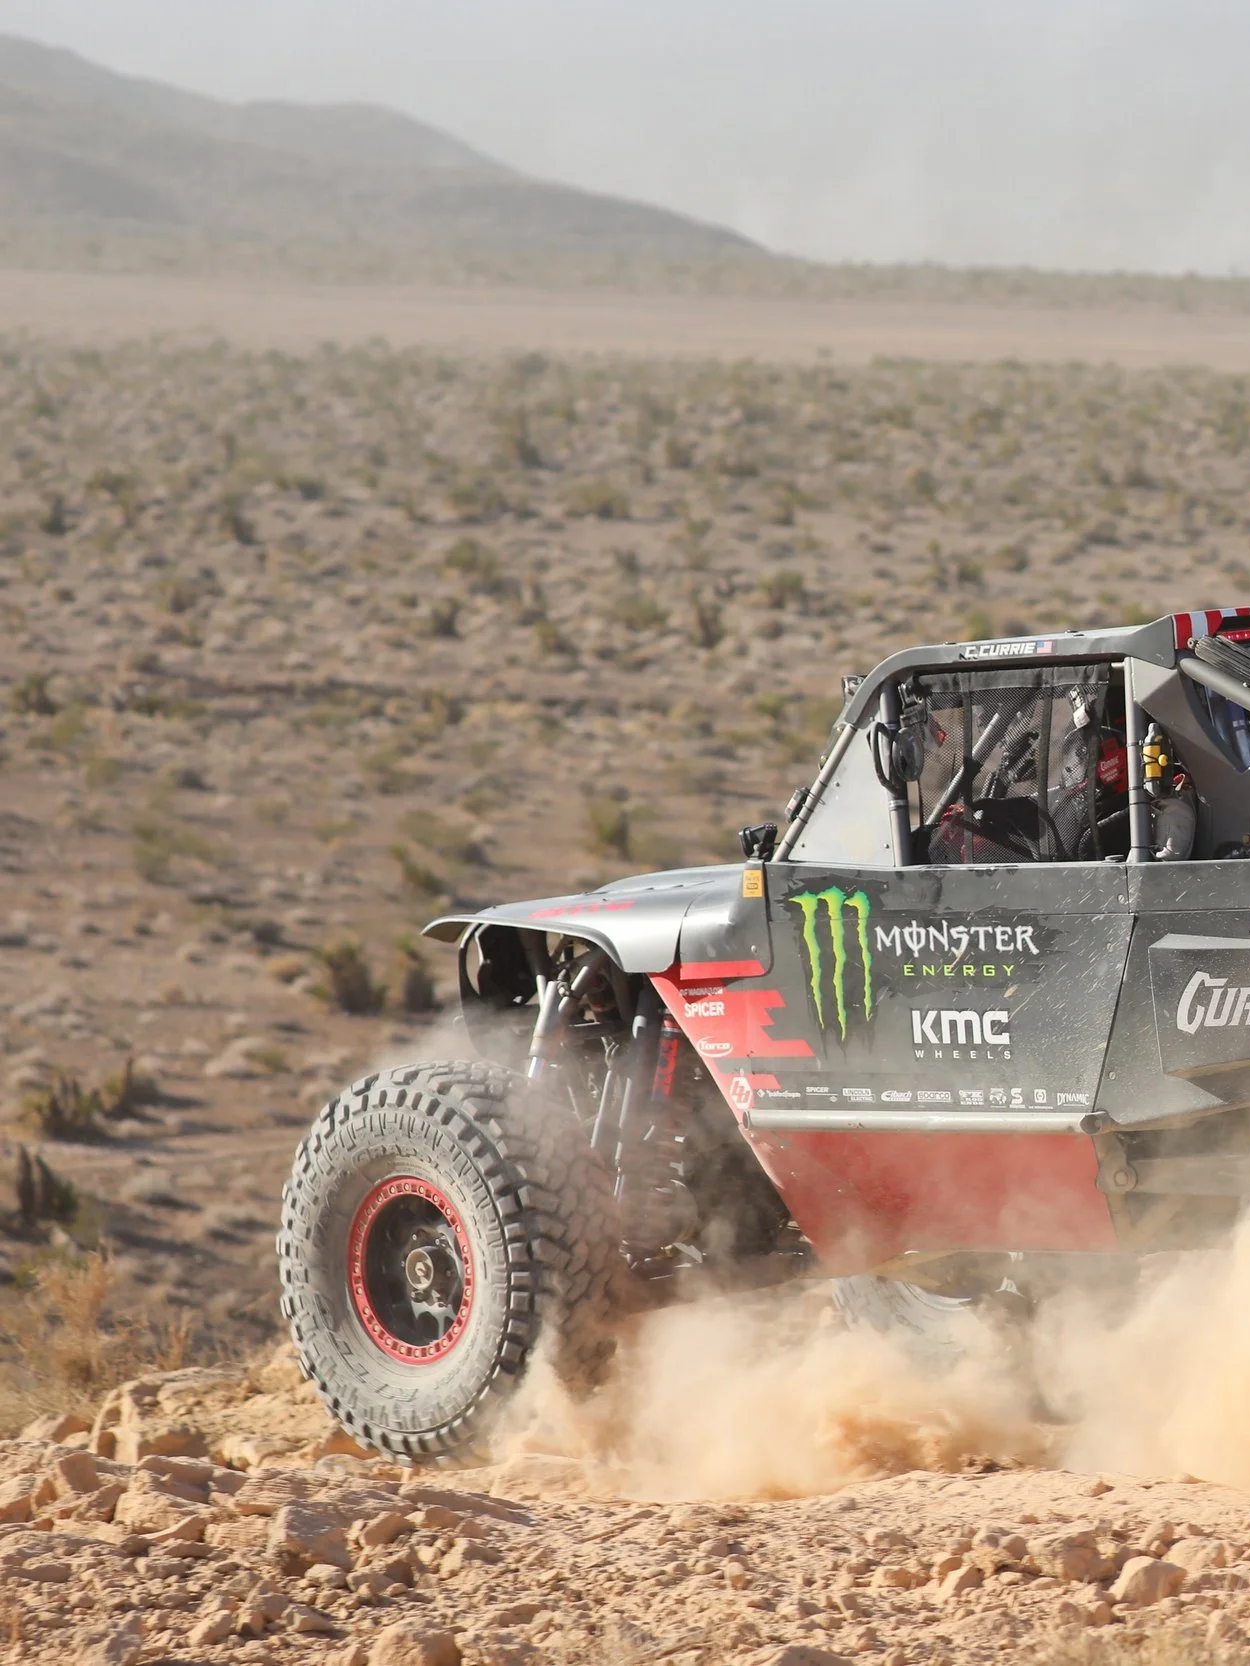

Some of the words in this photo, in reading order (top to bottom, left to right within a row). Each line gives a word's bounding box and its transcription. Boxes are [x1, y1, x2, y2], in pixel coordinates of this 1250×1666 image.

[875, 919, 1039, 957] MONSTER
[904, 964, 1015, 977] ENERGY
[684, 1001, 725, 1018] SPICER
[911, 1009, 1010, 1045] KMC
[914, 1049, 1012, 1060] WHEELS
[806, 1086, 829, 1094] SPICER
[1057, 1092, 1090, 1106] DYNAMIC
